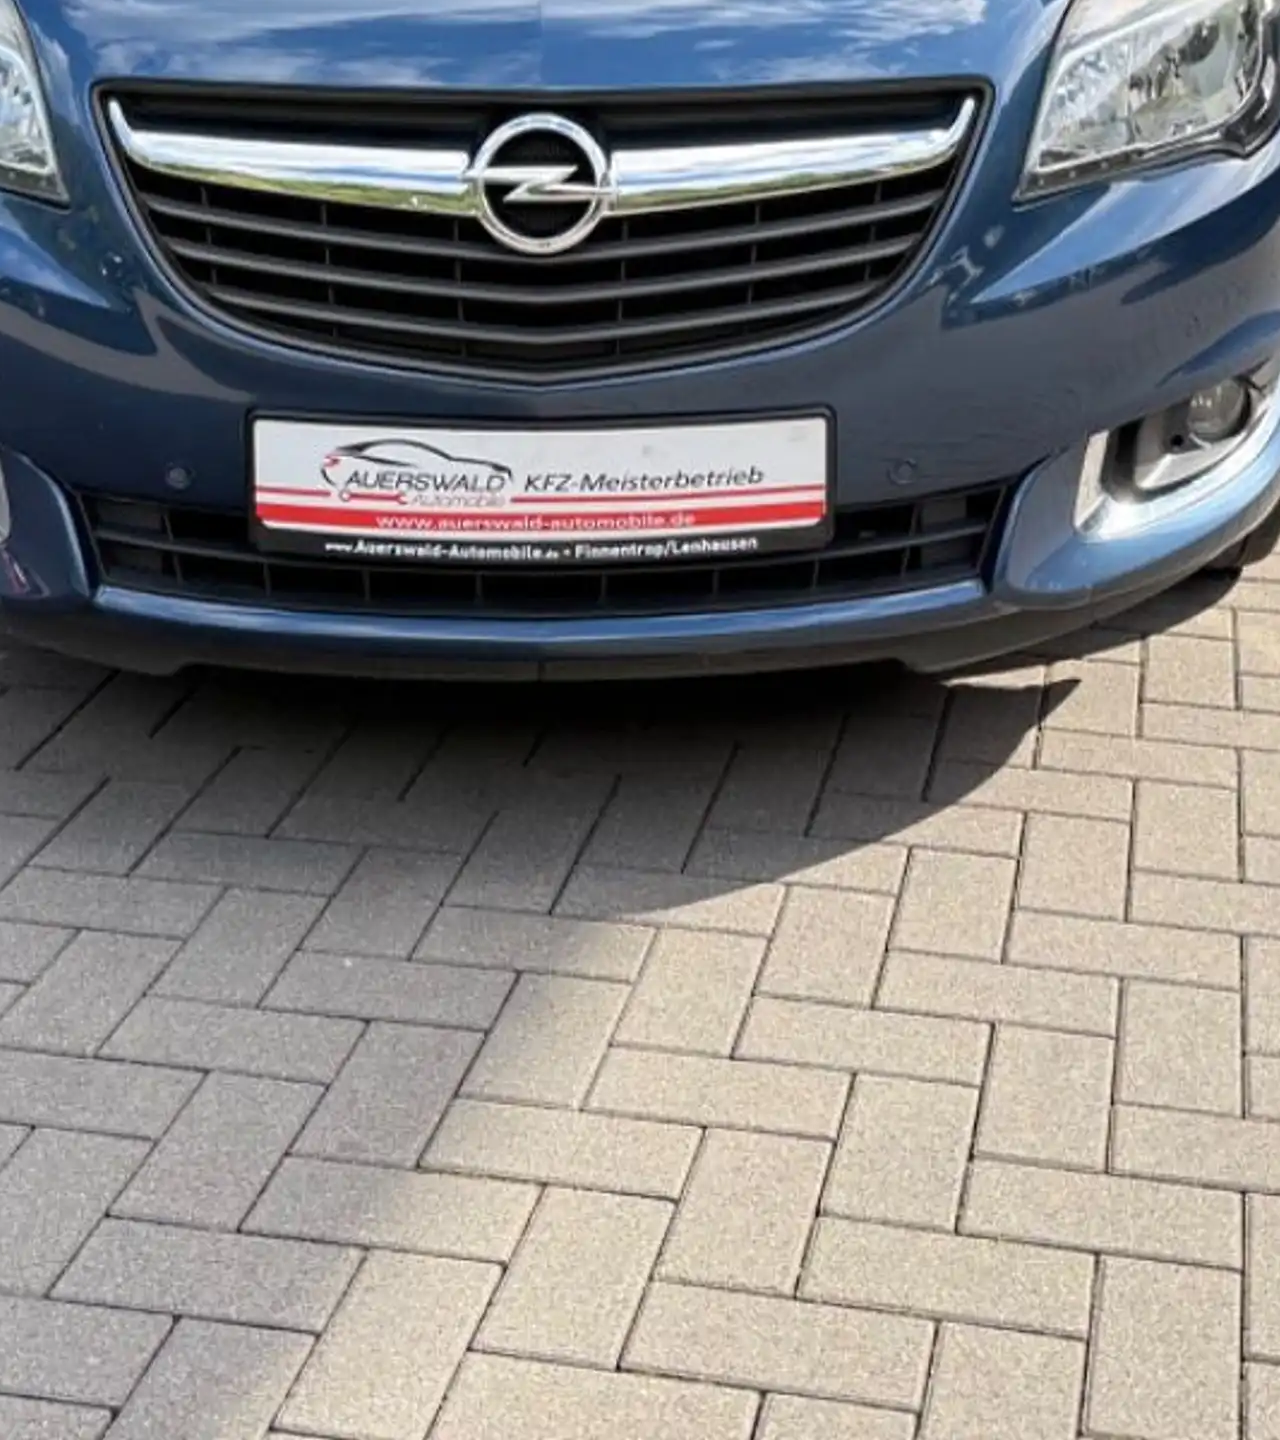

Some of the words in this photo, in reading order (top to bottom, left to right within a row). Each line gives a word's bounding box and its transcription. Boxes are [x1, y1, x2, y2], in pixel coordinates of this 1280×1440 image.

[344, 469, 507, 493] AUERSWALD
[523, 465, 765, 493] KFZ-Meisterbetrieb
[410, 493, 507, 508] Automobile
[375, 512, 697, 531] www.auerswald-automobile.de
